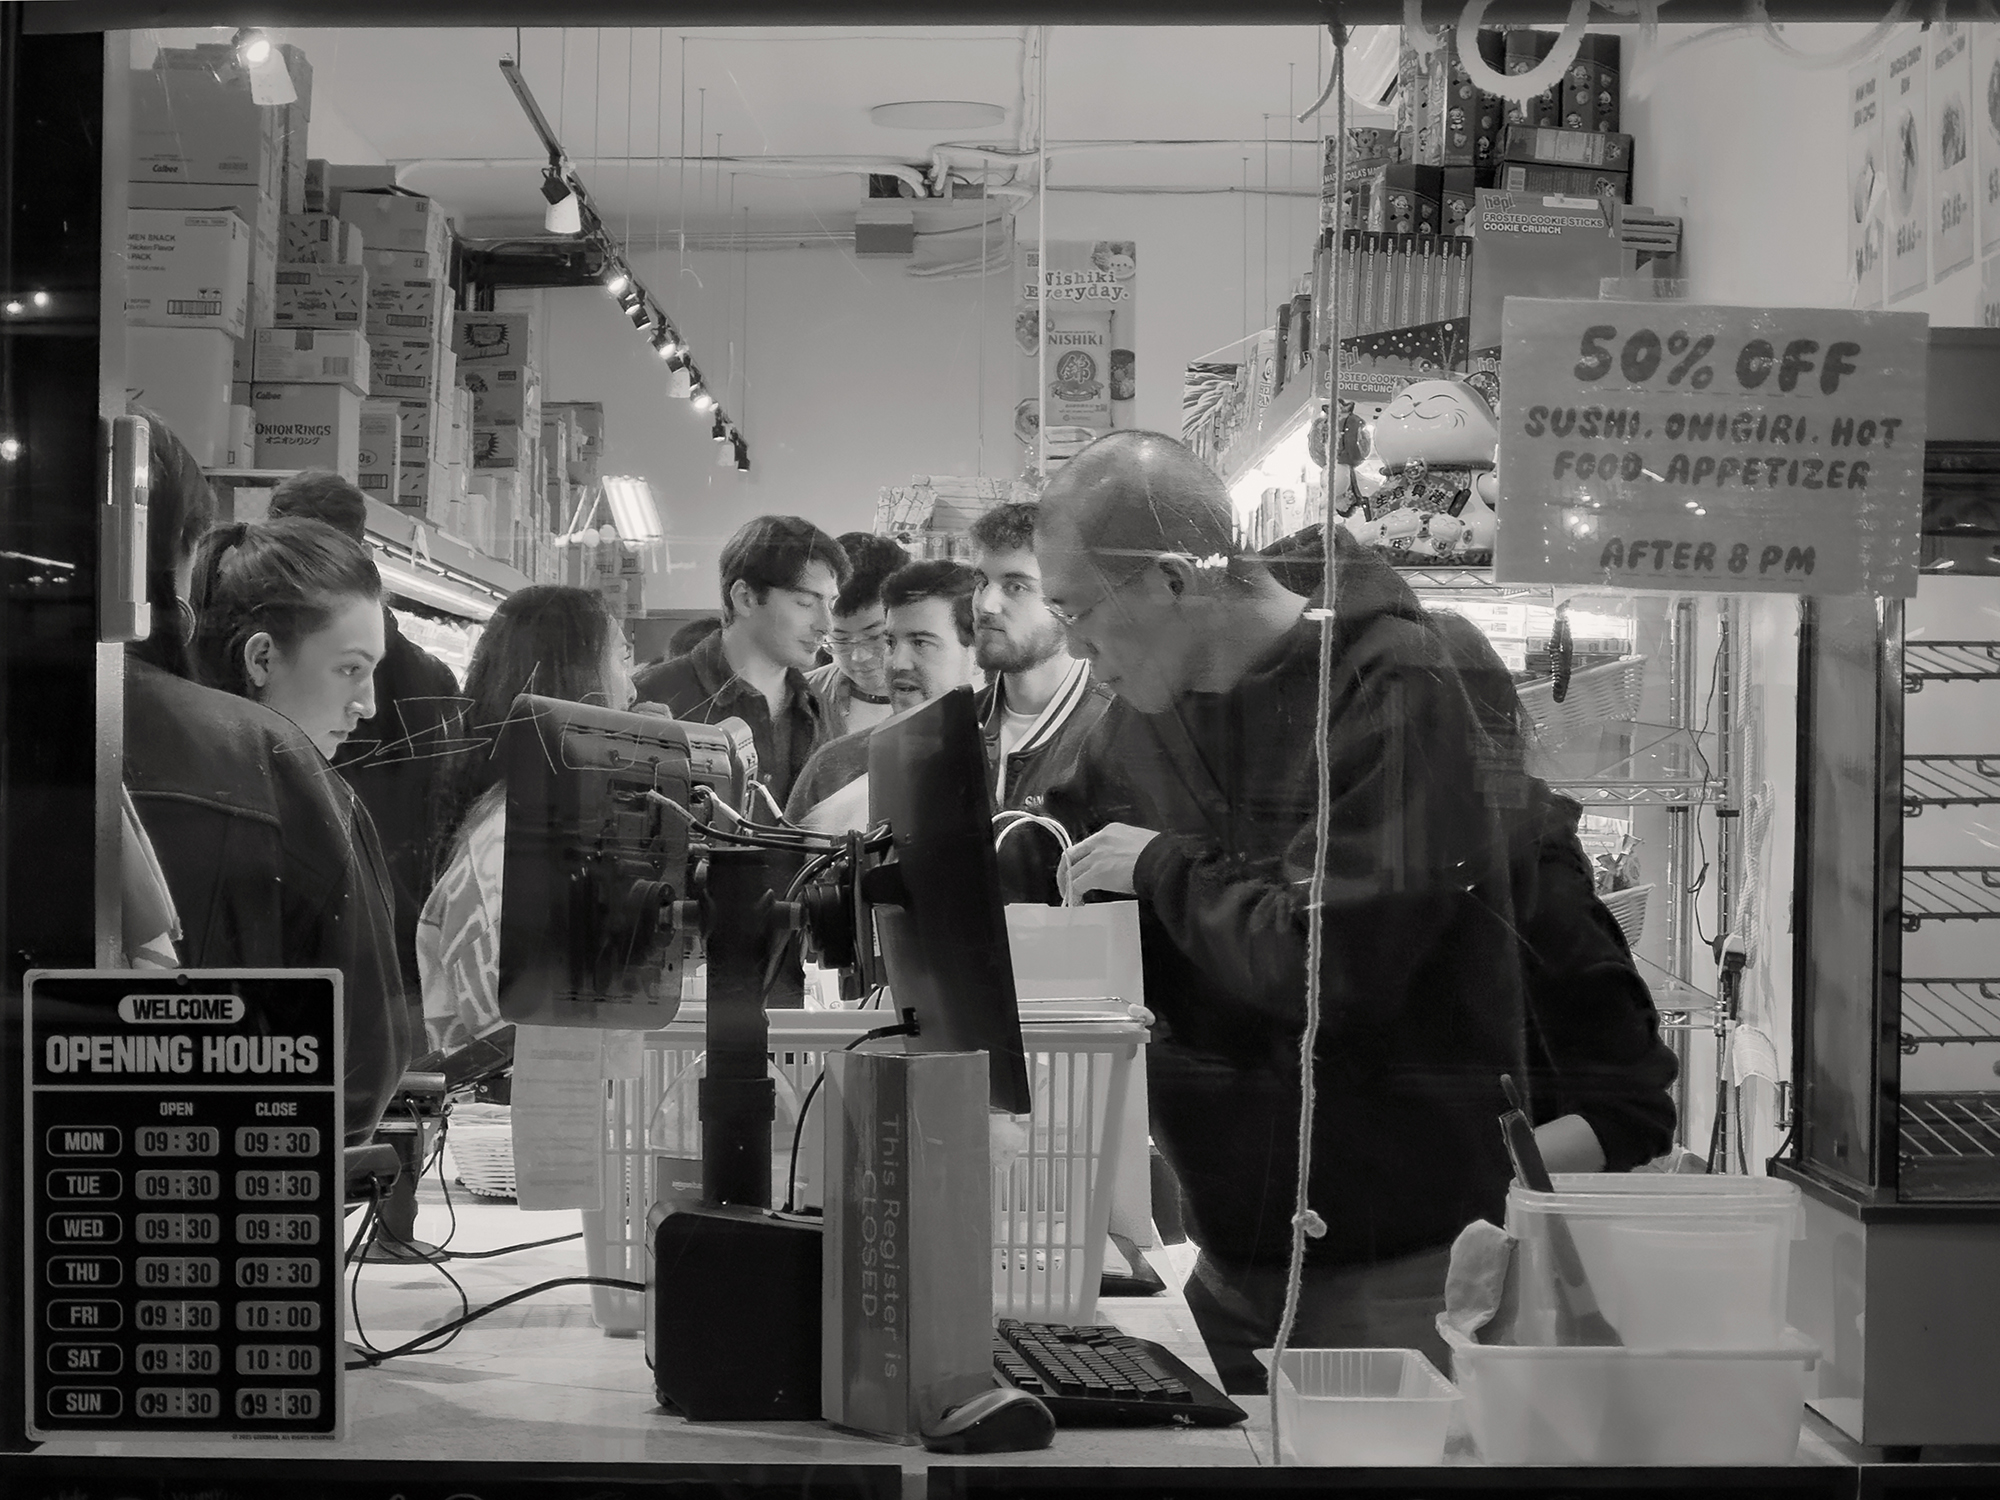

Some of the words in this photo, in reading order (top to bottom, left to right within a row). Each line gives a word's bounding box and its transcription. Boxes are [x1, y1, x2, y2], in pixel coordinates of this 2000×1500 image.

[152, 164, 178, 173] Calbee
[1483, 193, 1516, 212] hapi
[1483, 213, 1528, 223] FROSTED
[1530, 214, 1566, 226] COOKIE
[1568, 217, 1604, 228] STICKS
[1483, 223, 1519, 232] COOKIE
[1521, 225, 1562, 235] CRUNCH
[148, 234, 176, 242] SNACK
[1048, 334, 1104, 345] NISHIKI
[1329, 345, 1360, 371] api
[1574, 325, 1714, 389] 50%
[1735, 338, 1861, 395] OFF
[1062, 355, 1090, 383] 錦
[1325, 370, 1368, 382] FOSTED
[255, 391, 281, 400] Calbee
[1325, 381, 1359, 391] COKIE
[1361, 384, 1393, 394] CRUNC
[1831, 417, 1902, 448] HOT
[1665, 453, 1871, 490] APPETIZER
[1600, 538, 1717, 571] AFTER
[1728, 543, 1748, 573] 8
[1759, 544, 1816, 575] PM
[133, 998, 233, 1020] WELCOME
[46, 1035, 192, 1073] OPENING
[203, 1035, 318, 1073] HOURS
[159, 1102, 193, 1116] OPEN
[255, 1102, 297, 1116] CLOSE
[65, 1131, 104, 1151] MON
[882, 1114, 900, 1186] This
[66, 1175, 100, 1195] TUE
[64, 1219, 103, 1238] WED
[861, 1170, 878, 1317] CLOSED
[66, 1262, 99, 1282] THU
[879, 1200, 901, 1341] Register
[70, 1305, 99, 1325] FRI
[67, 1349, 101, 1369] SAT
[884, 1353, 901, 1378] is
[66, 1393, 101, 1412] SUN
